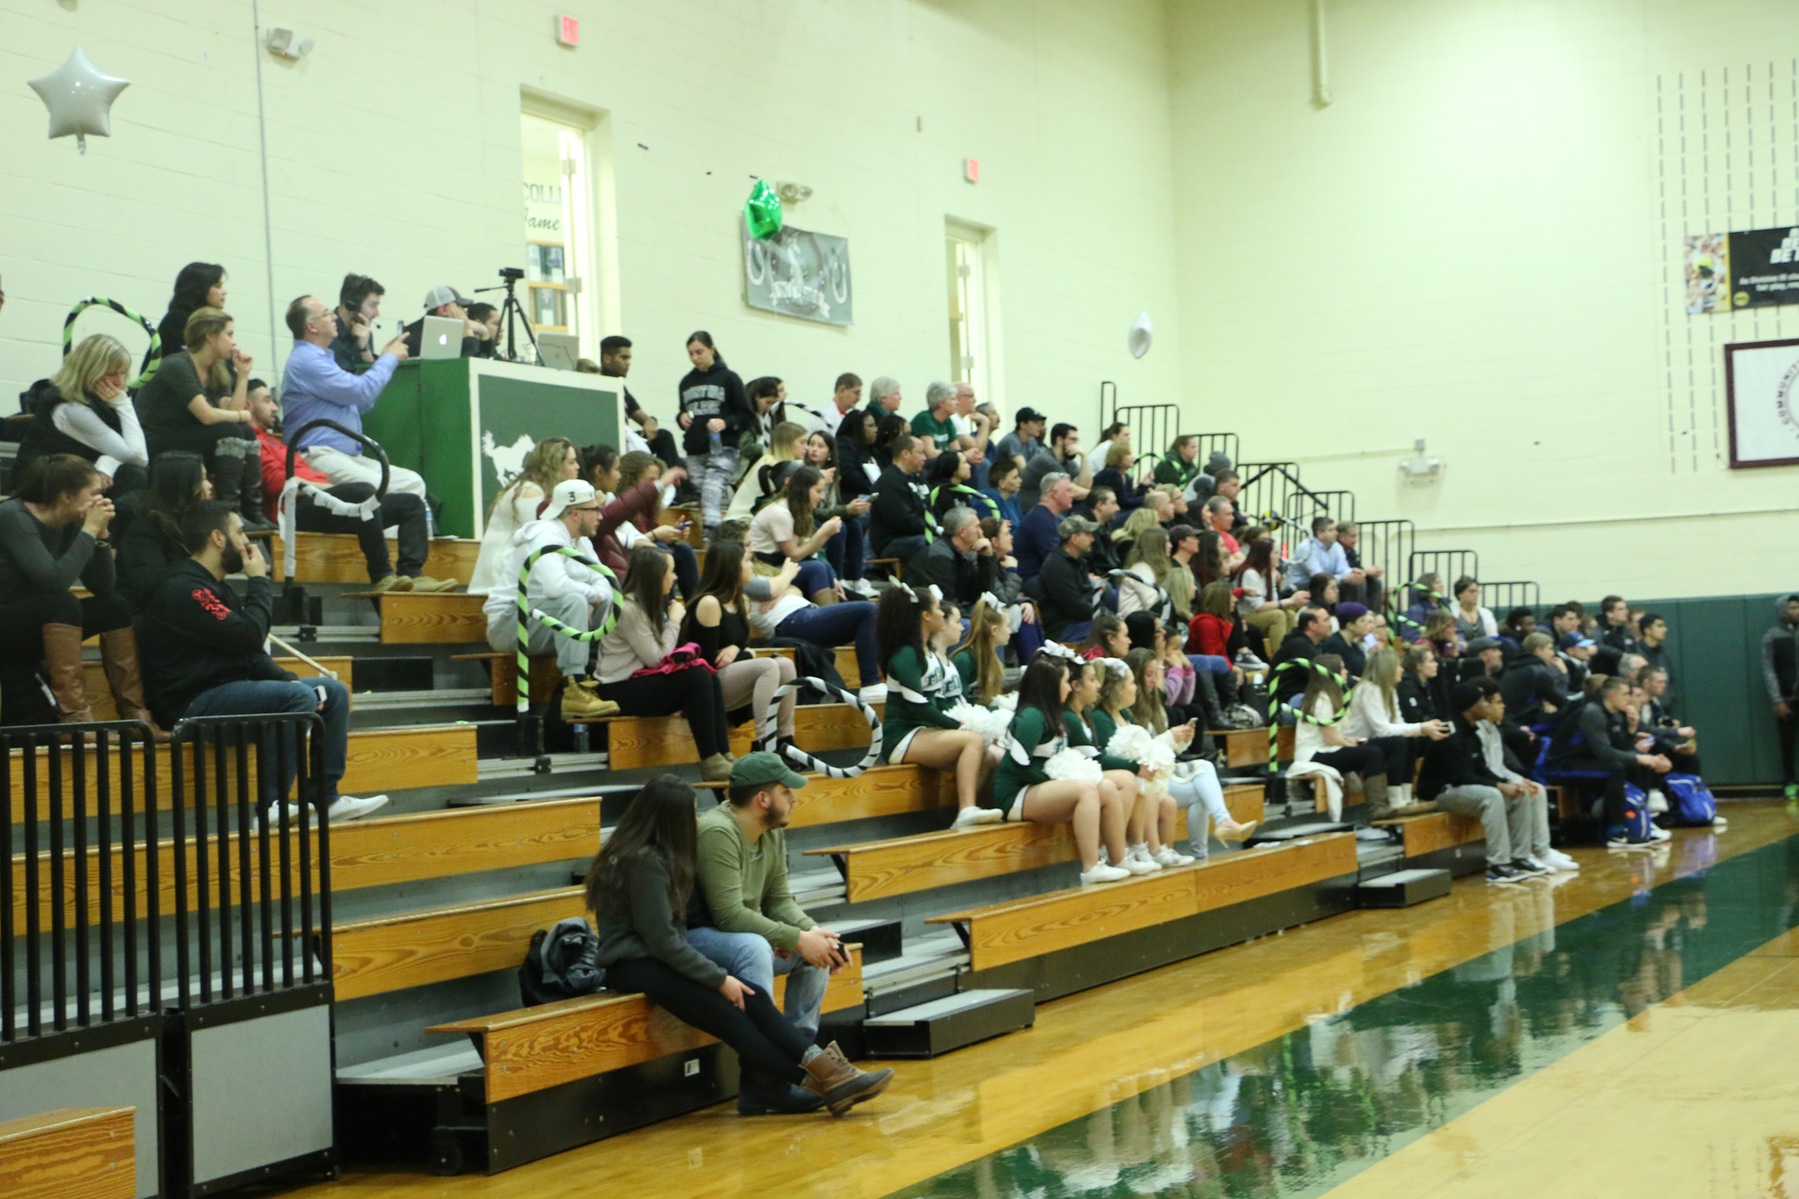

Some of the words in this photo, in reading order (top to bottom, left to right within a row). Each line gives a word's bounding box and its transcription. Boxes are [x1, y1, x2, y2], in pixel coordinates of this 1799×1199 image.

[523, 182, 561, 204] COLL
[1776, 359, 1799, 425] COMMUNIT
[568, 491, 576, 503] 3
